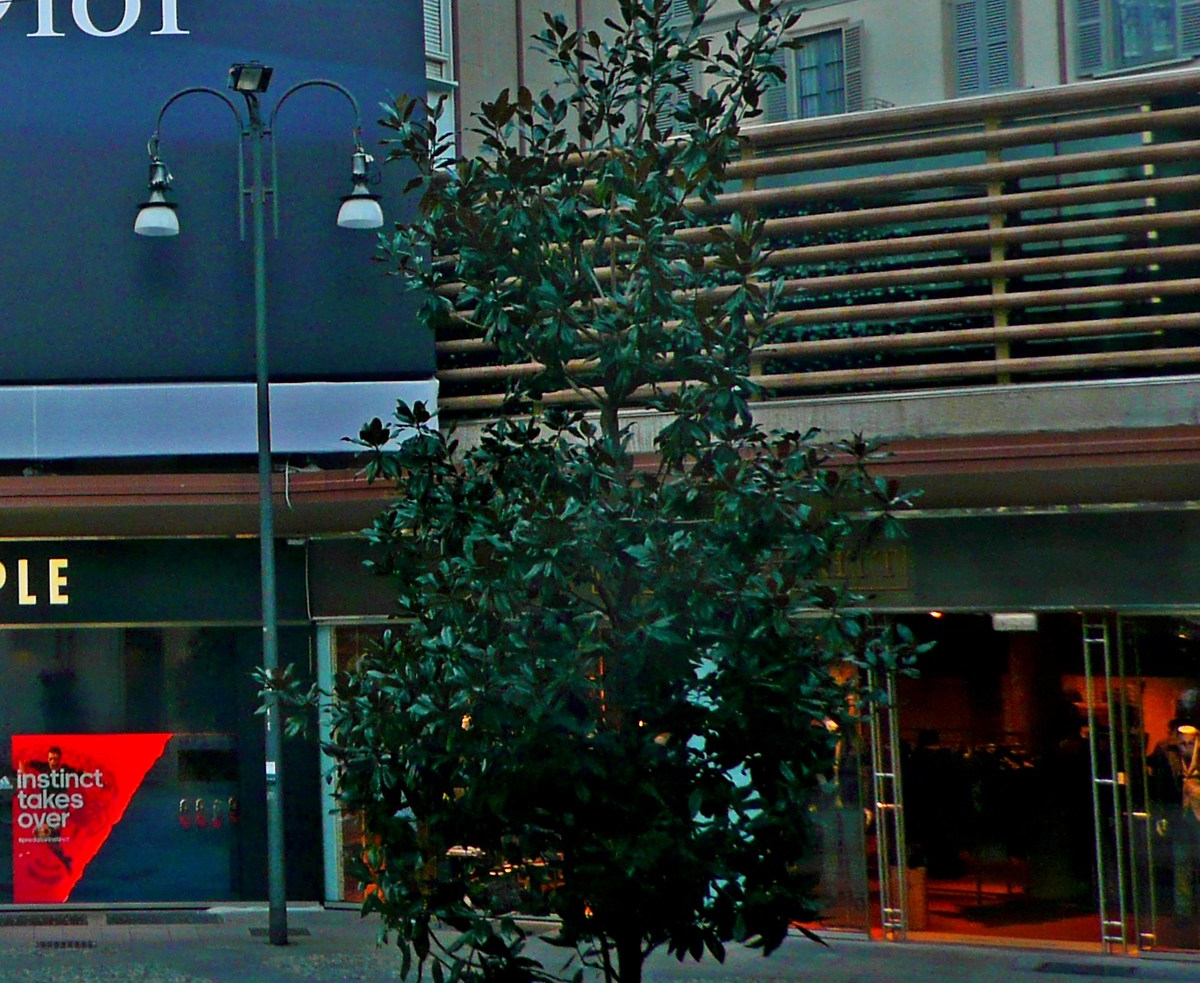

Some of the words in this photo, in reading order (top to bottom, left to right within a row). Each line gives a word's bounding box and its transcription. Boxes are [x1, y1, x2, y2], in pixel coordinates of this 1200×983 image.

[16, 768, 104, 789] instinct
[17, 789, 84, 810] takes
[17, 811, 71, 829] over
